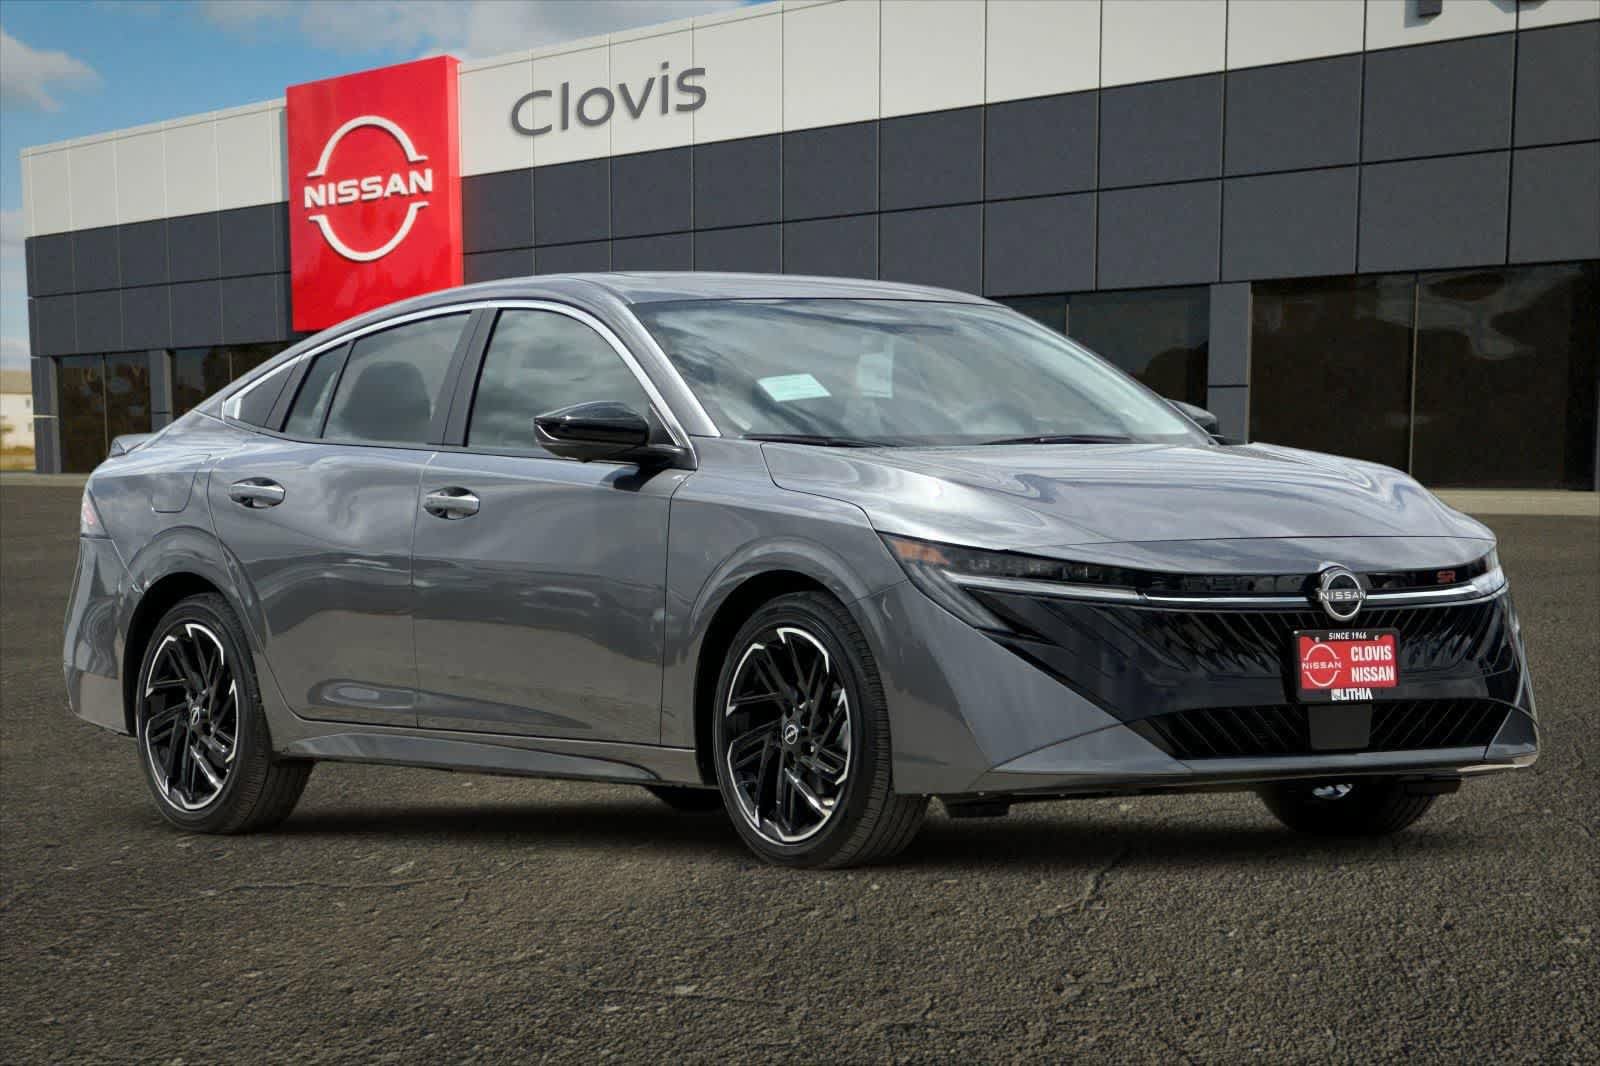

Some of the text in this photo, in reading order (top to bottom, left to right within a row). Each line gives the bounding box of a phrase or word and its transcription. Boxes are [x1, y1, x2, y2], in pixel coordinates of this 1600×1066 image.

[510, 62, 707, 137] Clovis
[303, 168, 433, 209] NISSAN
[1319, 590, 1367, 601] NISSAN
[1328, 631, 1350, 640] SINCE
[1350, 646, 1392, 661] CLOVIS
[1302, 661, 1342, 670] NISSAN
[1351, 666, 1395, 682] NISSAN
[1340, 688, 1373, 701] LITHIA
